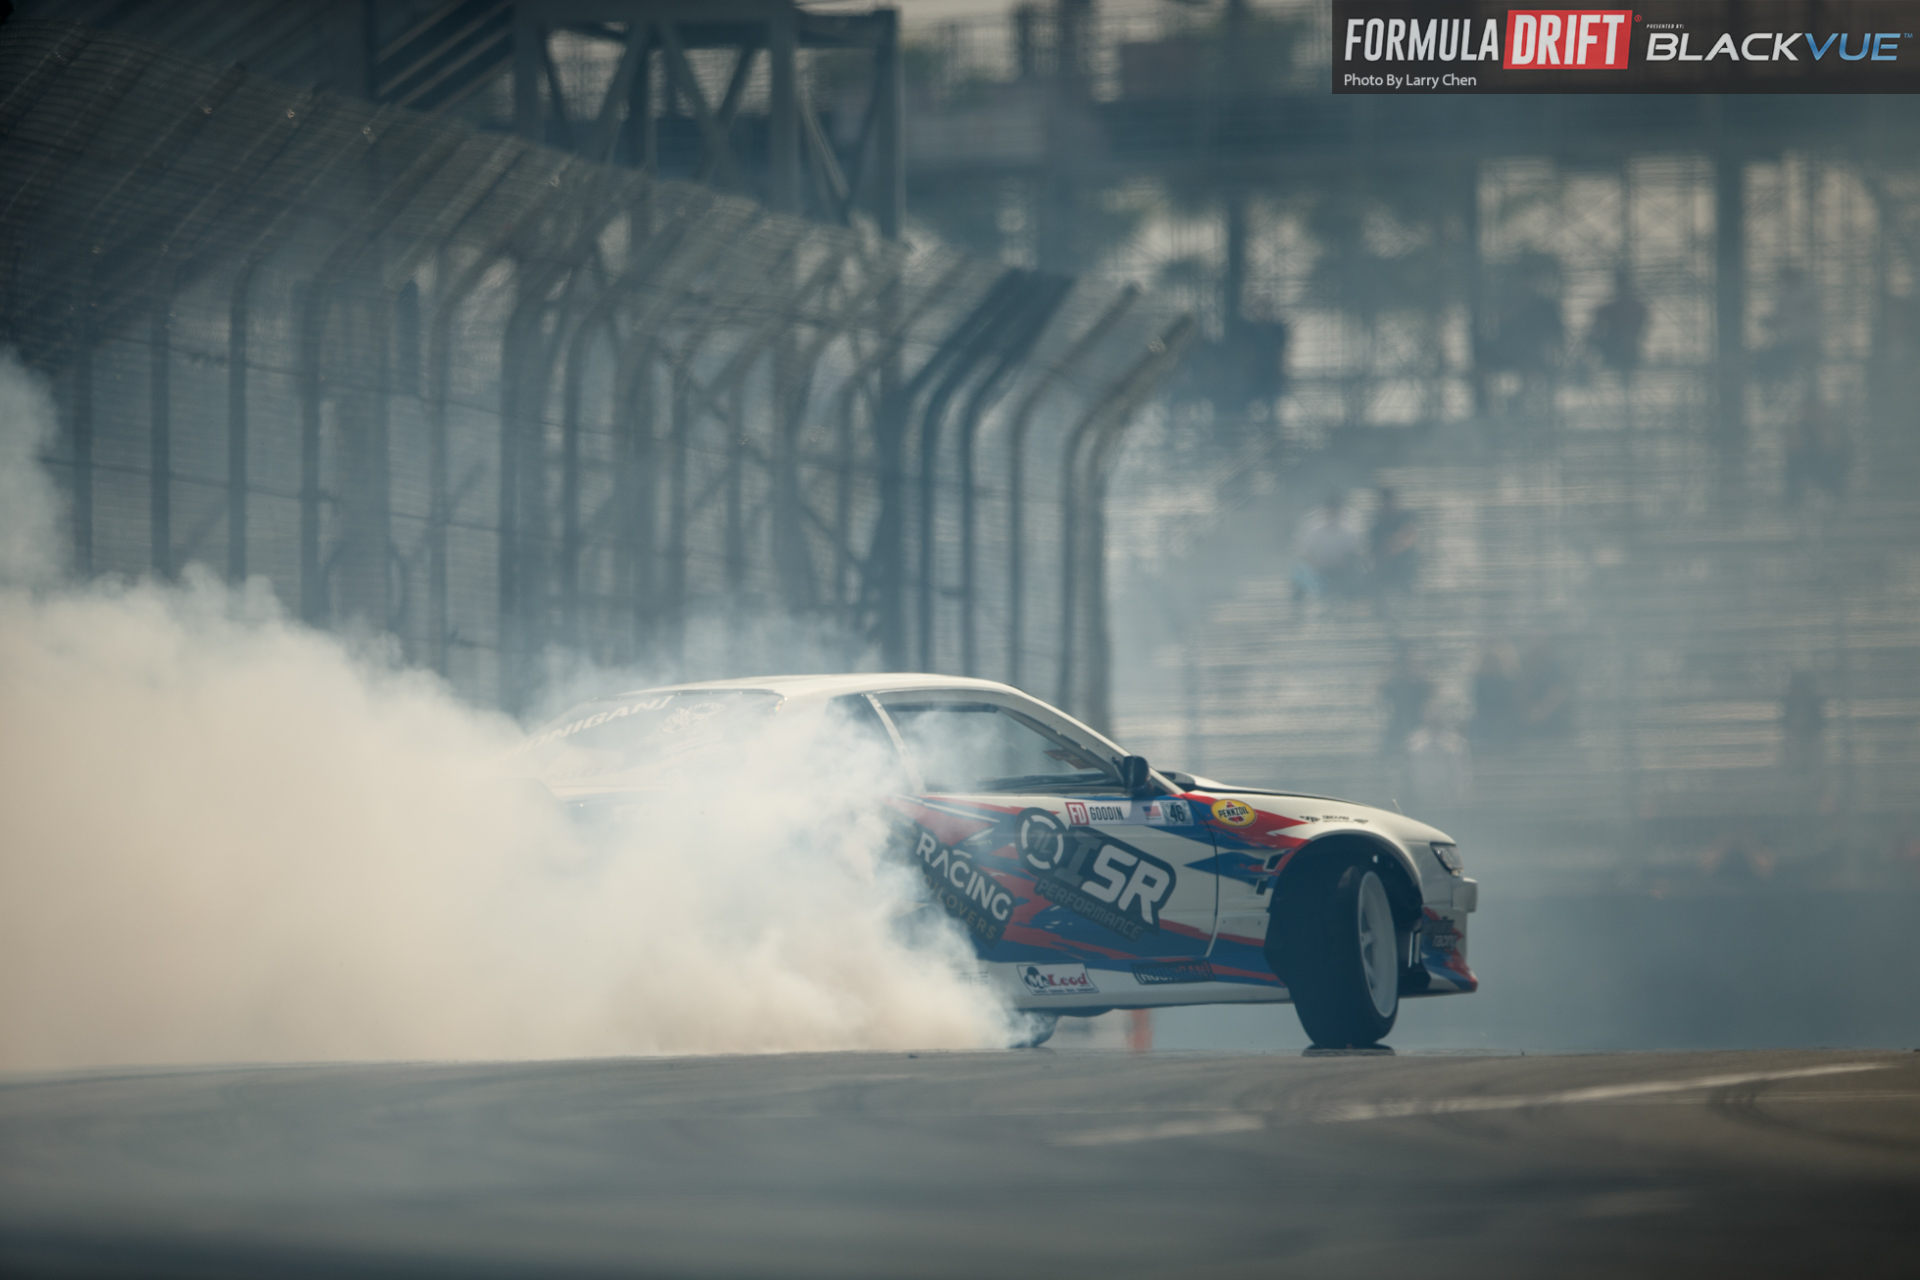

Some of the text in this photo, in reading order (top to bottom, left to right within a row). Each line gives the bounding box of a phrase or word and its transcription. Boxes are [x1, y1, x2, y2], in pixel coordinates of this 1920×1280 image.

[1068, 804, 1186, 824] FD GOODIN 46
[1217, 805, 1250, 819] PENNZOIL
[916, 832, 1012, 921] RACING
[1036, 879, 1144, 940] PERFORMANCE
